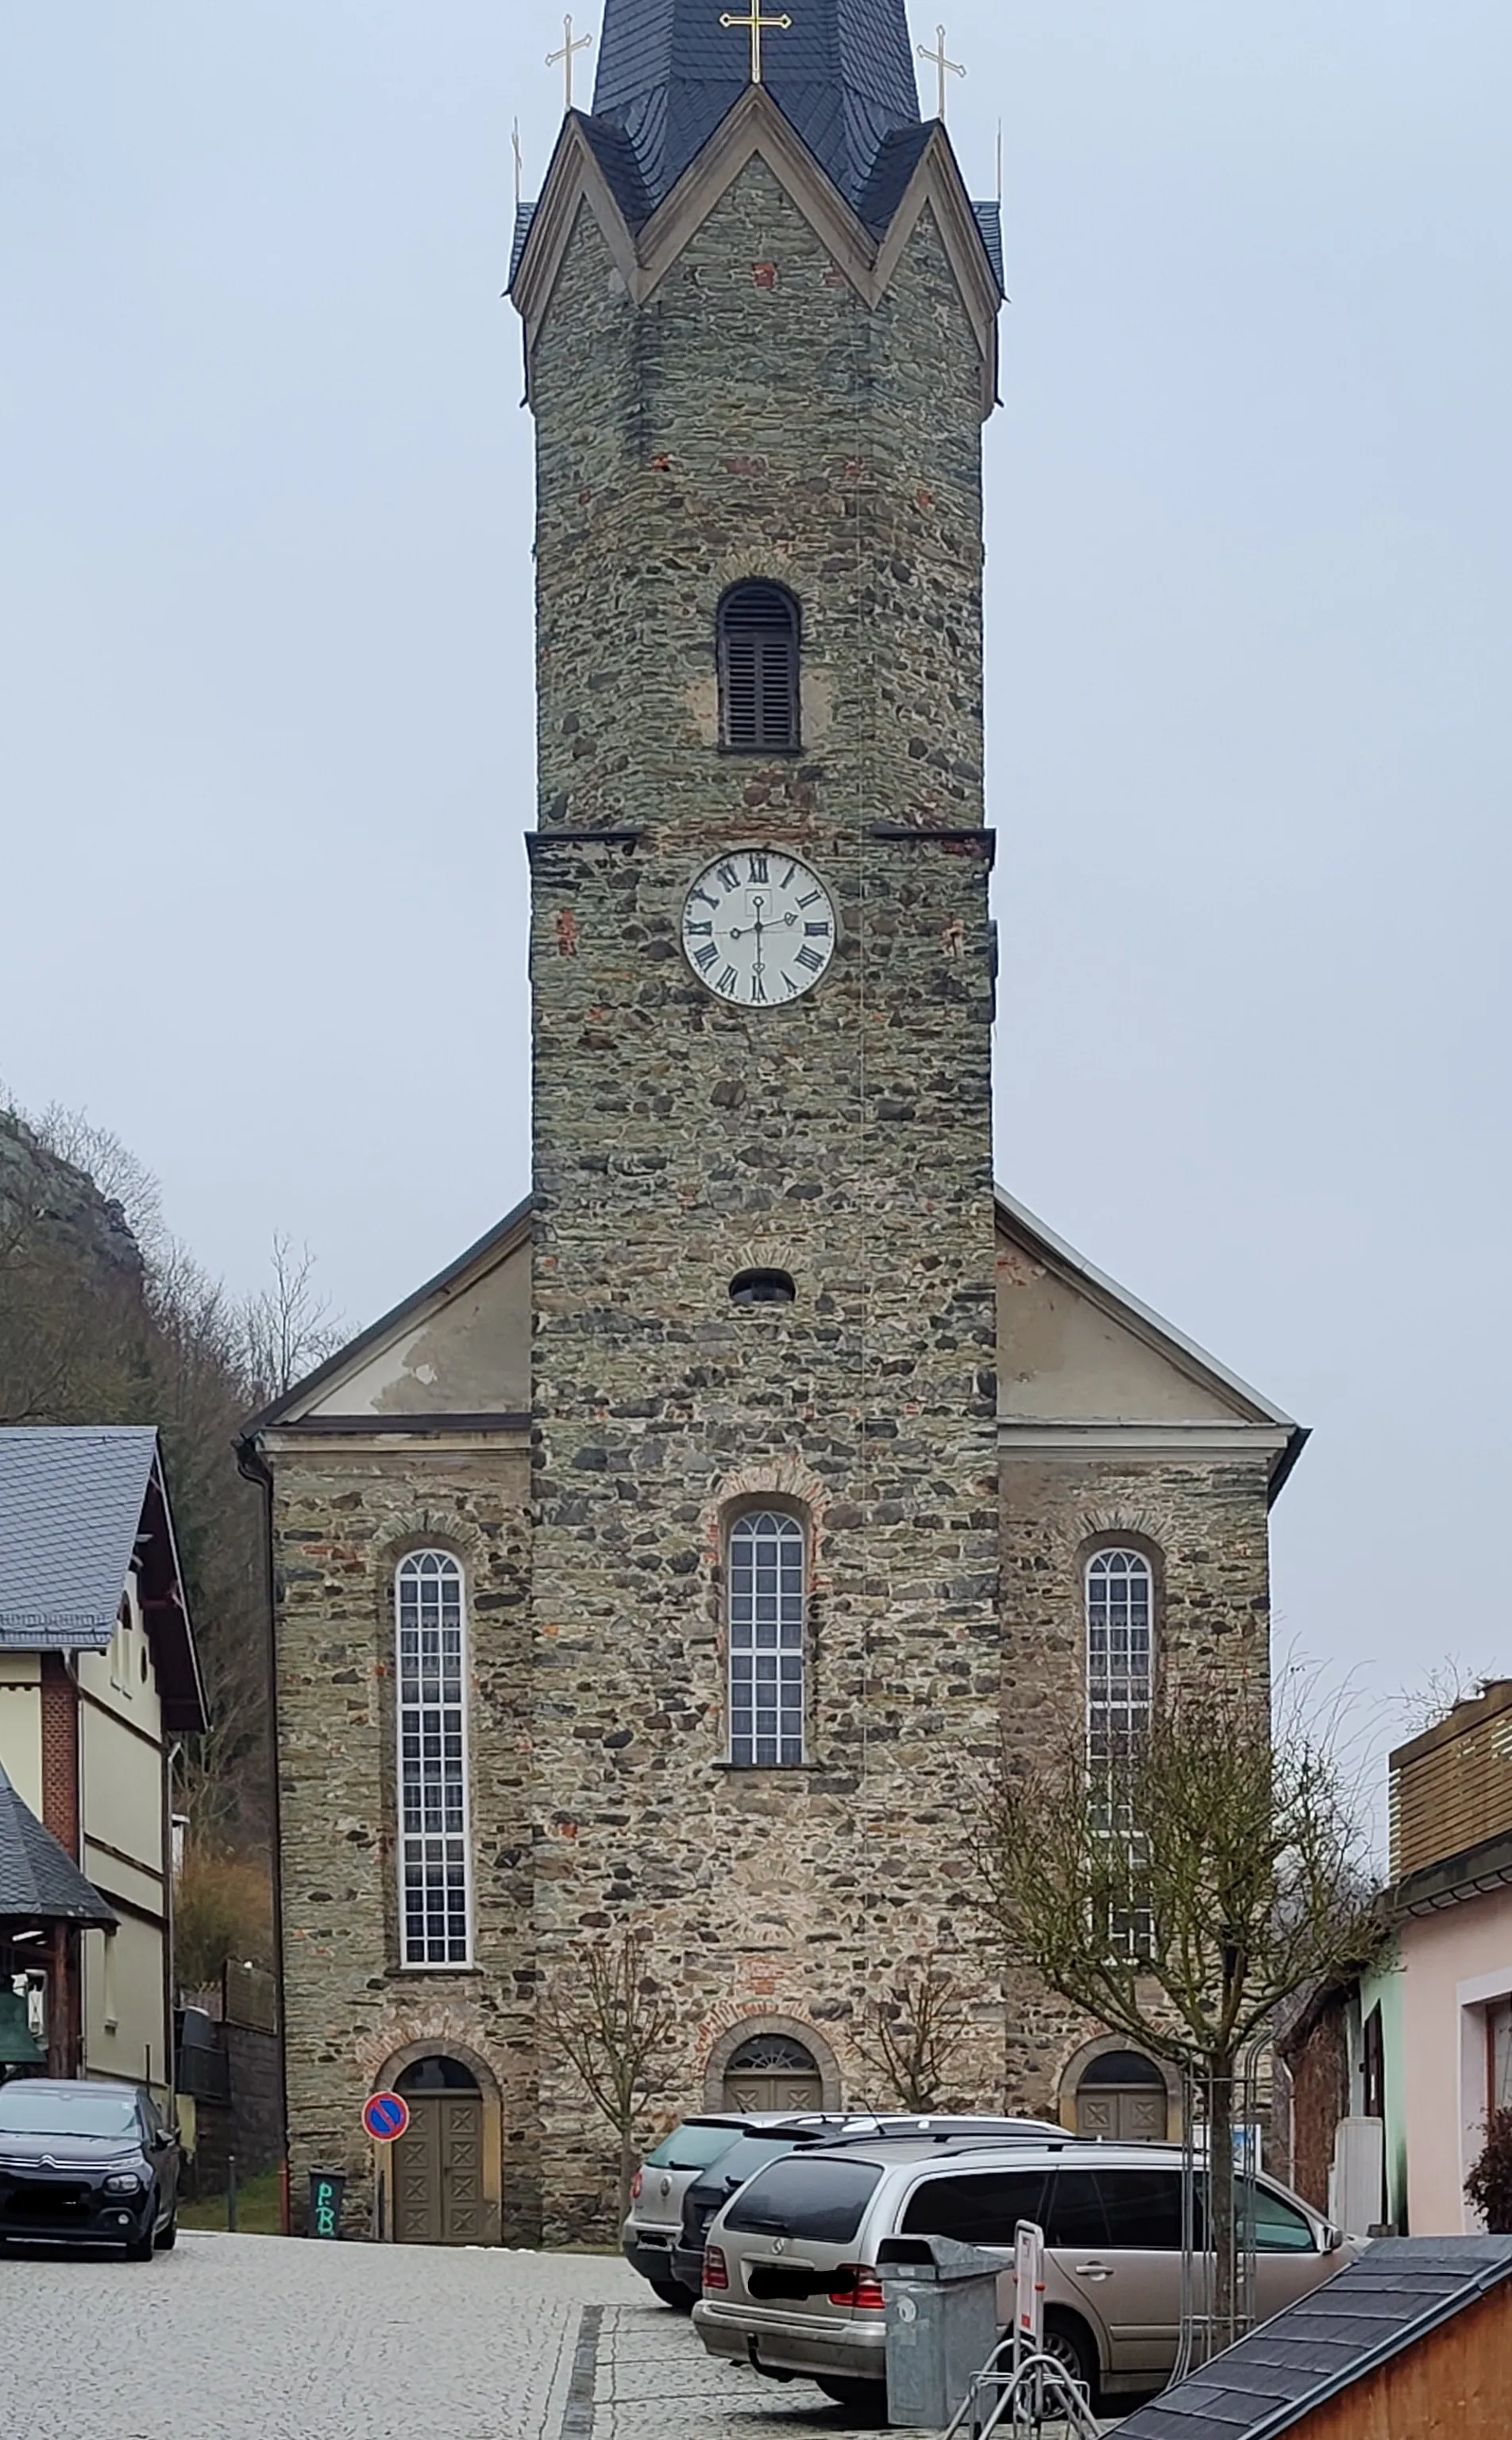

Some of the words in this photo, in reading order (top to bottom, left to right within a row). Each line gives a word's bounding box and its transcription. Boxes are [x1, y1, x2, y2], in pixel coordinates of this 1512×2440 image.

[748, 853, 769, 883] XII
[780, 863, 796, 890] I
[795, 890, 821, 911] II
[685, 919, 712, 936] IX
[804, 921, 830, 936] III
[693, 942, 720, 978] VIII
[715, 964, 739, 995] VII
[780, 970, 798, 993] V
